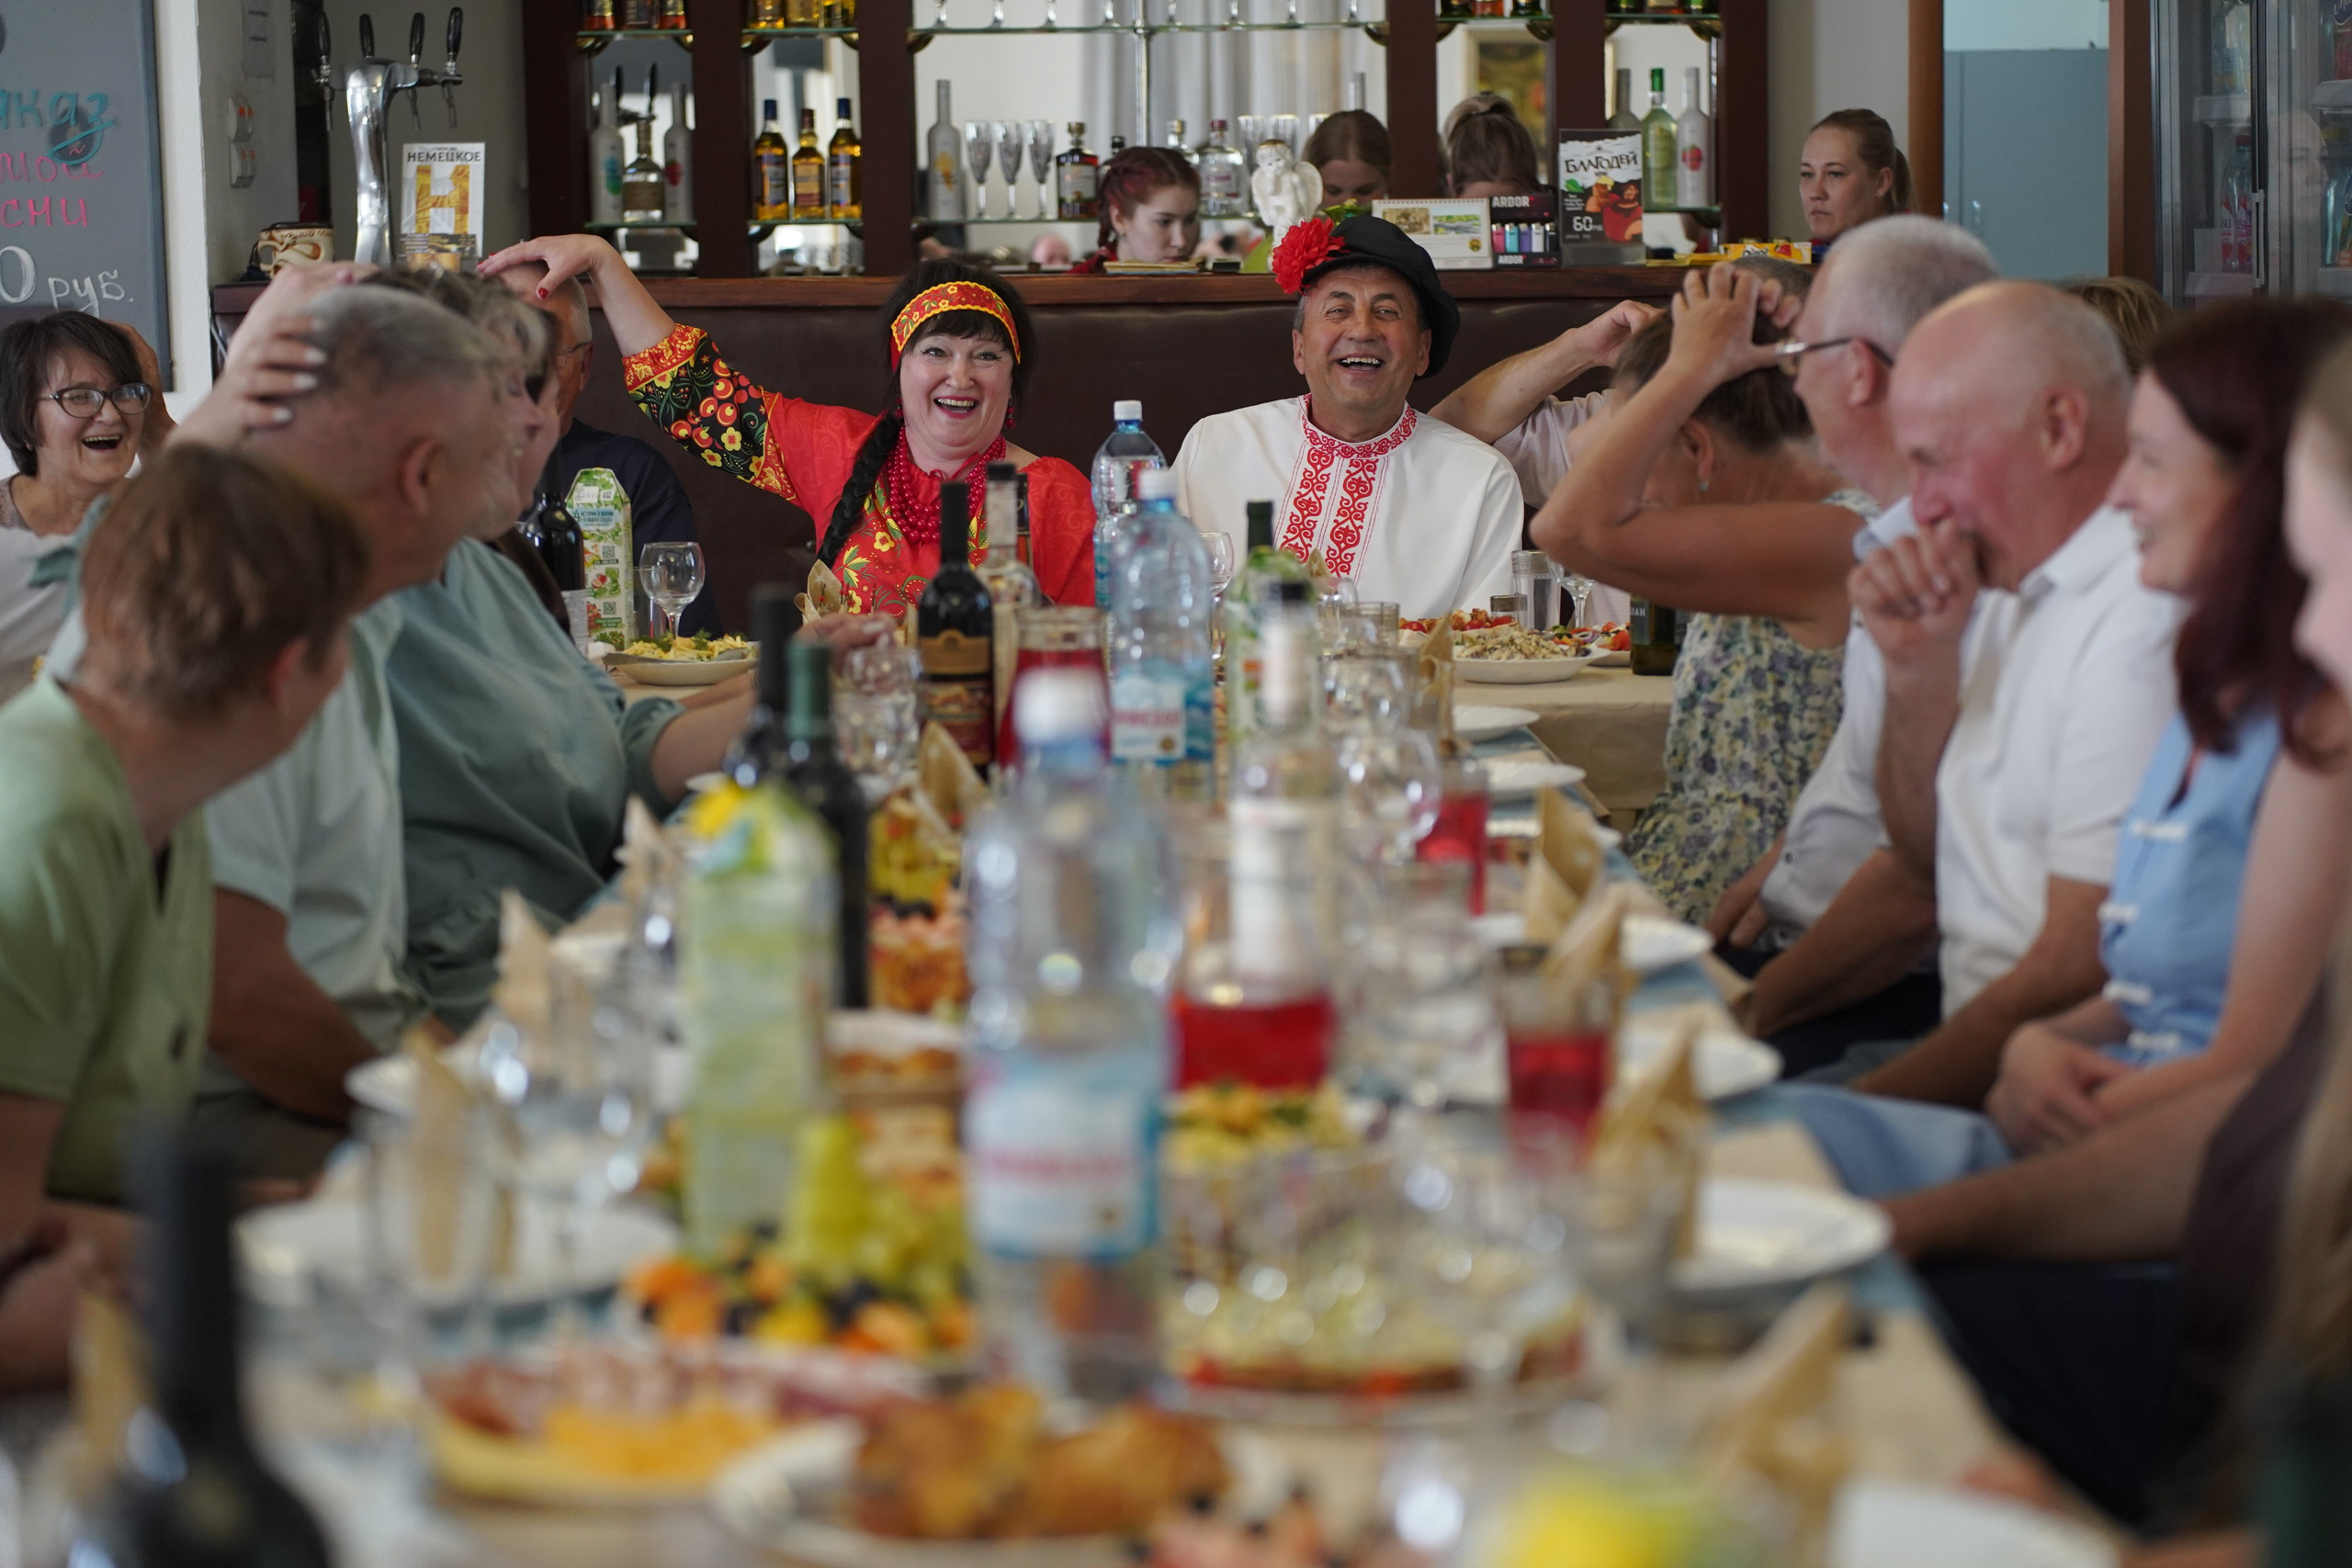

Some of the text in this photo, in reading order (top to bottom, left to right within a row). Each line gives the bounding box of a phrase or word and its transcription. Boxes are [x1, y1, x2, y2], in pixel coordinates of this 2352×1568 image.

[407, 152, 482, 163] НЕМЕЦКОЕ
[1565, 151, 1638, 174] БЛАГОДЕЙ
[1491, 196, 1531, 208] ARDOR
[1573, 216, 1593, 231] 60
[1498, 254, 1524, 265] ARDOR
